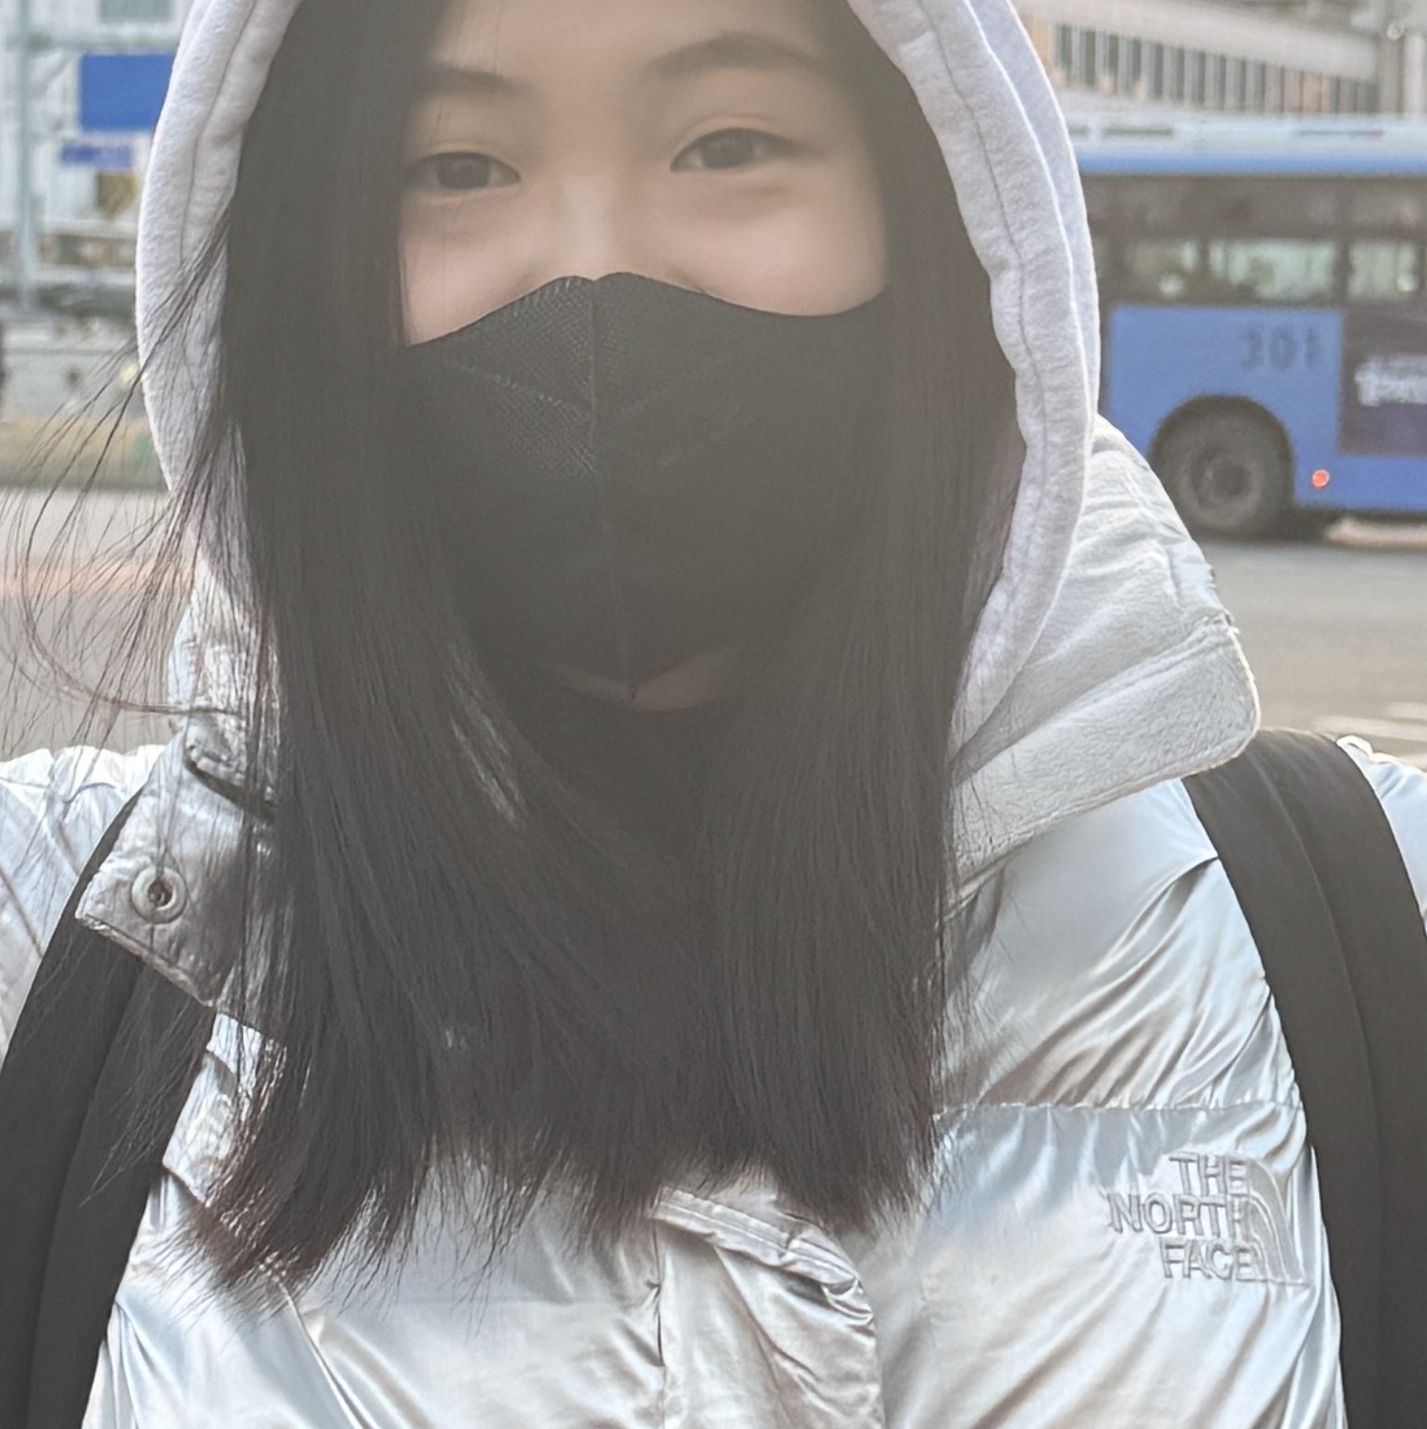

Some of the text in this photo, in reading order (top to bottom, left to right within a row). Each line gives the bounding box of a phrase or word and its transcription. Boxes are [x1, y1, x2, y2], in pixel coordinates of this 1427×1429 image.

[1169, 1151, 1251, 1197] THE
[1104, 1191, 1250, 1240] NORTH
[1160, 1239, 1256, 1282] FACE
